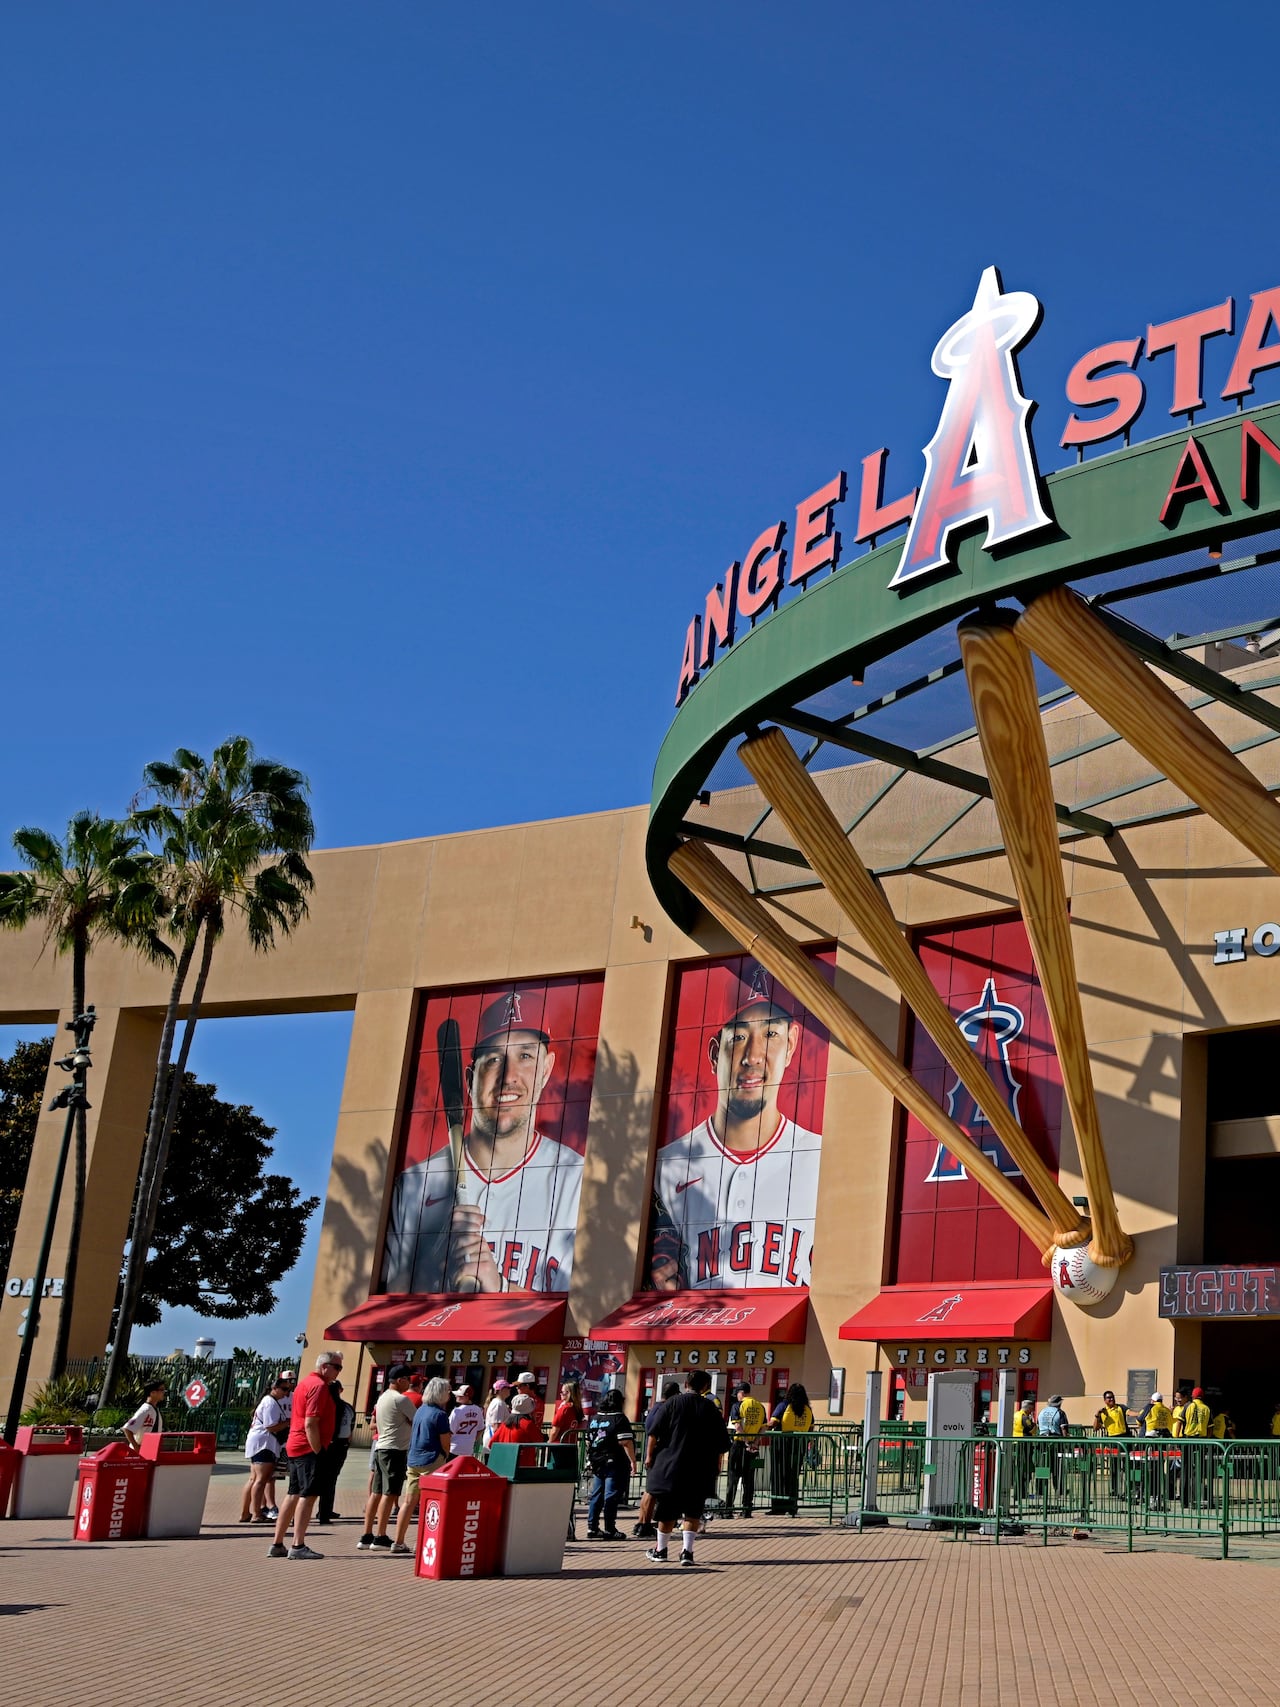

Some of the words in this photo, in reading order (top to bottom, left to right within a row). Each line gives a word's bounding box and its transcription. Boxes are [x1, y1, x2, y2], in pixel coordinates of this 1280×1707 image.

[887, 264, 1054, 592] A
[1161, 1268, 1275, 1315] LIGHT
[630, 1301, 756, 1327] ANGELS
[405, 1349, 514, 1363] TICKETS
[655, 1350, 775, 1365] TICKETS
[897, 1348, 1031, 1364] TICKETS
[190, 1384, 201, 1400] 2
[455, 1421, 478, 1435] 27
[942, 1422, 965, 1431] evolv
[108, 1478, 129, 1538] RECYCLE
[460, 1500, 481, 1576] RECYCLE
